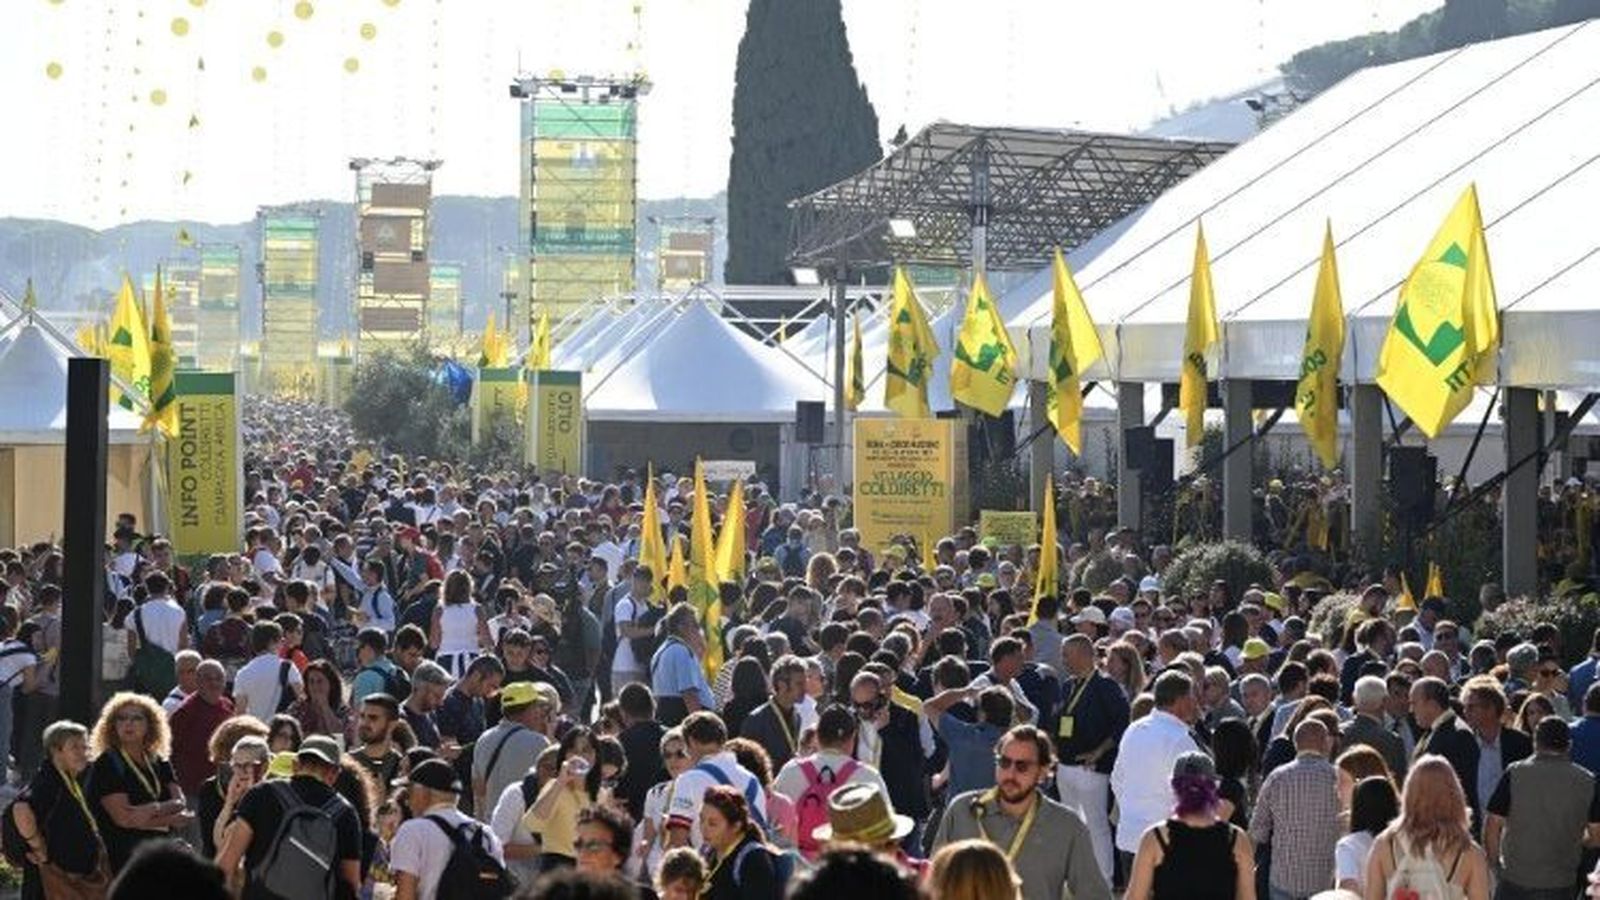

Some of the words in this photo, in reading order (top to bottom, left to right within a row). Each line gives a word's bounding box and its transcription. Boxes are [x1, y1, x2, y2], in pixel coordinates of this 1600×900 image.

[558, 391, 573, 434] OLIO
[180, 403, 197, 470] POINT
[181, 475, 198, 527] INFO
[859, 481, 945, 497] COLDIRETTI
